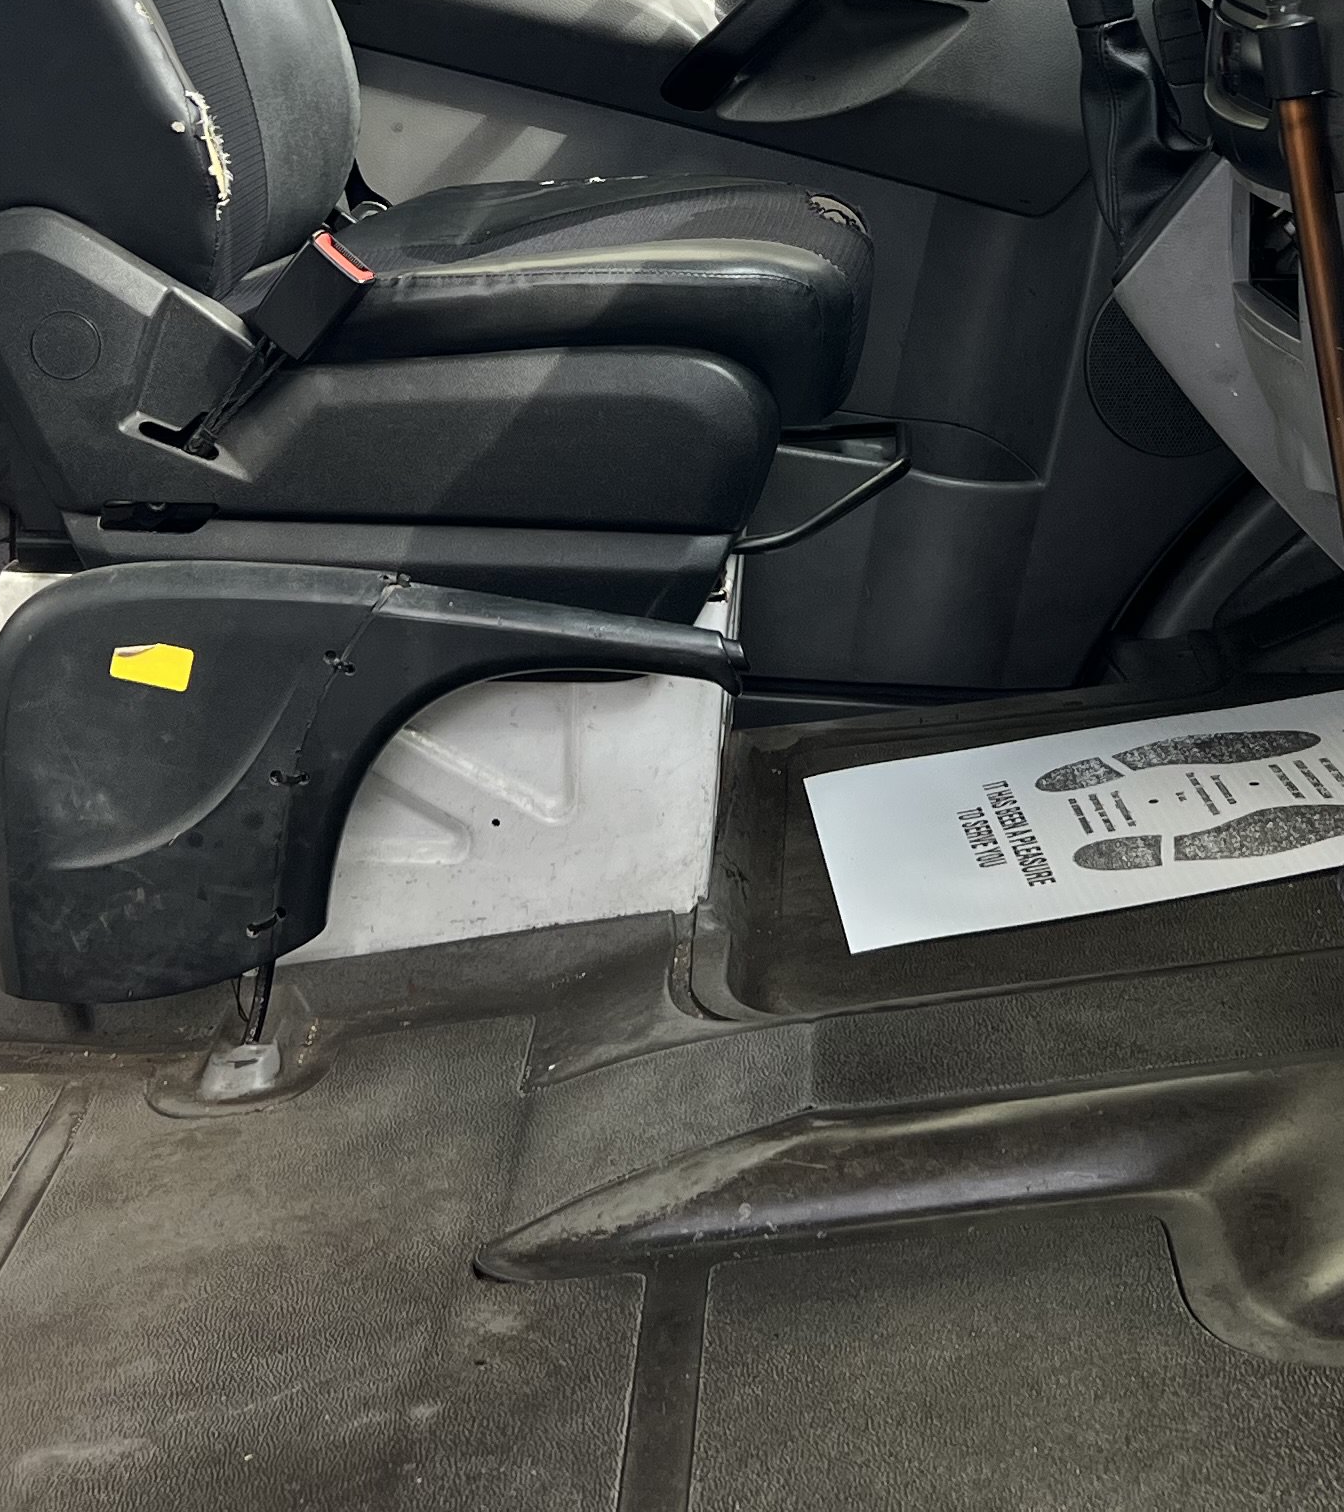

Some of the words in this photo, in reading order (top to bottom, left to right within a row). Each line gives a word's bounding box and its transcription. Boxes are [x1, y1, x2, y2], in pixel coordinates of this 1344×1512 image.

[982, 780, 1009, 790] IT
[987, 789, 1018, 808] HAS
[957, 807, 985, 820] TO
[995, 806, 1029, 831] BEEN
[962, 820, 998, 849] SERVE
[1005, 829, 1032, 838] A
[975, 846, 1007, 868] YOU
[1009, 835, 1056, 887] PLEASURE
